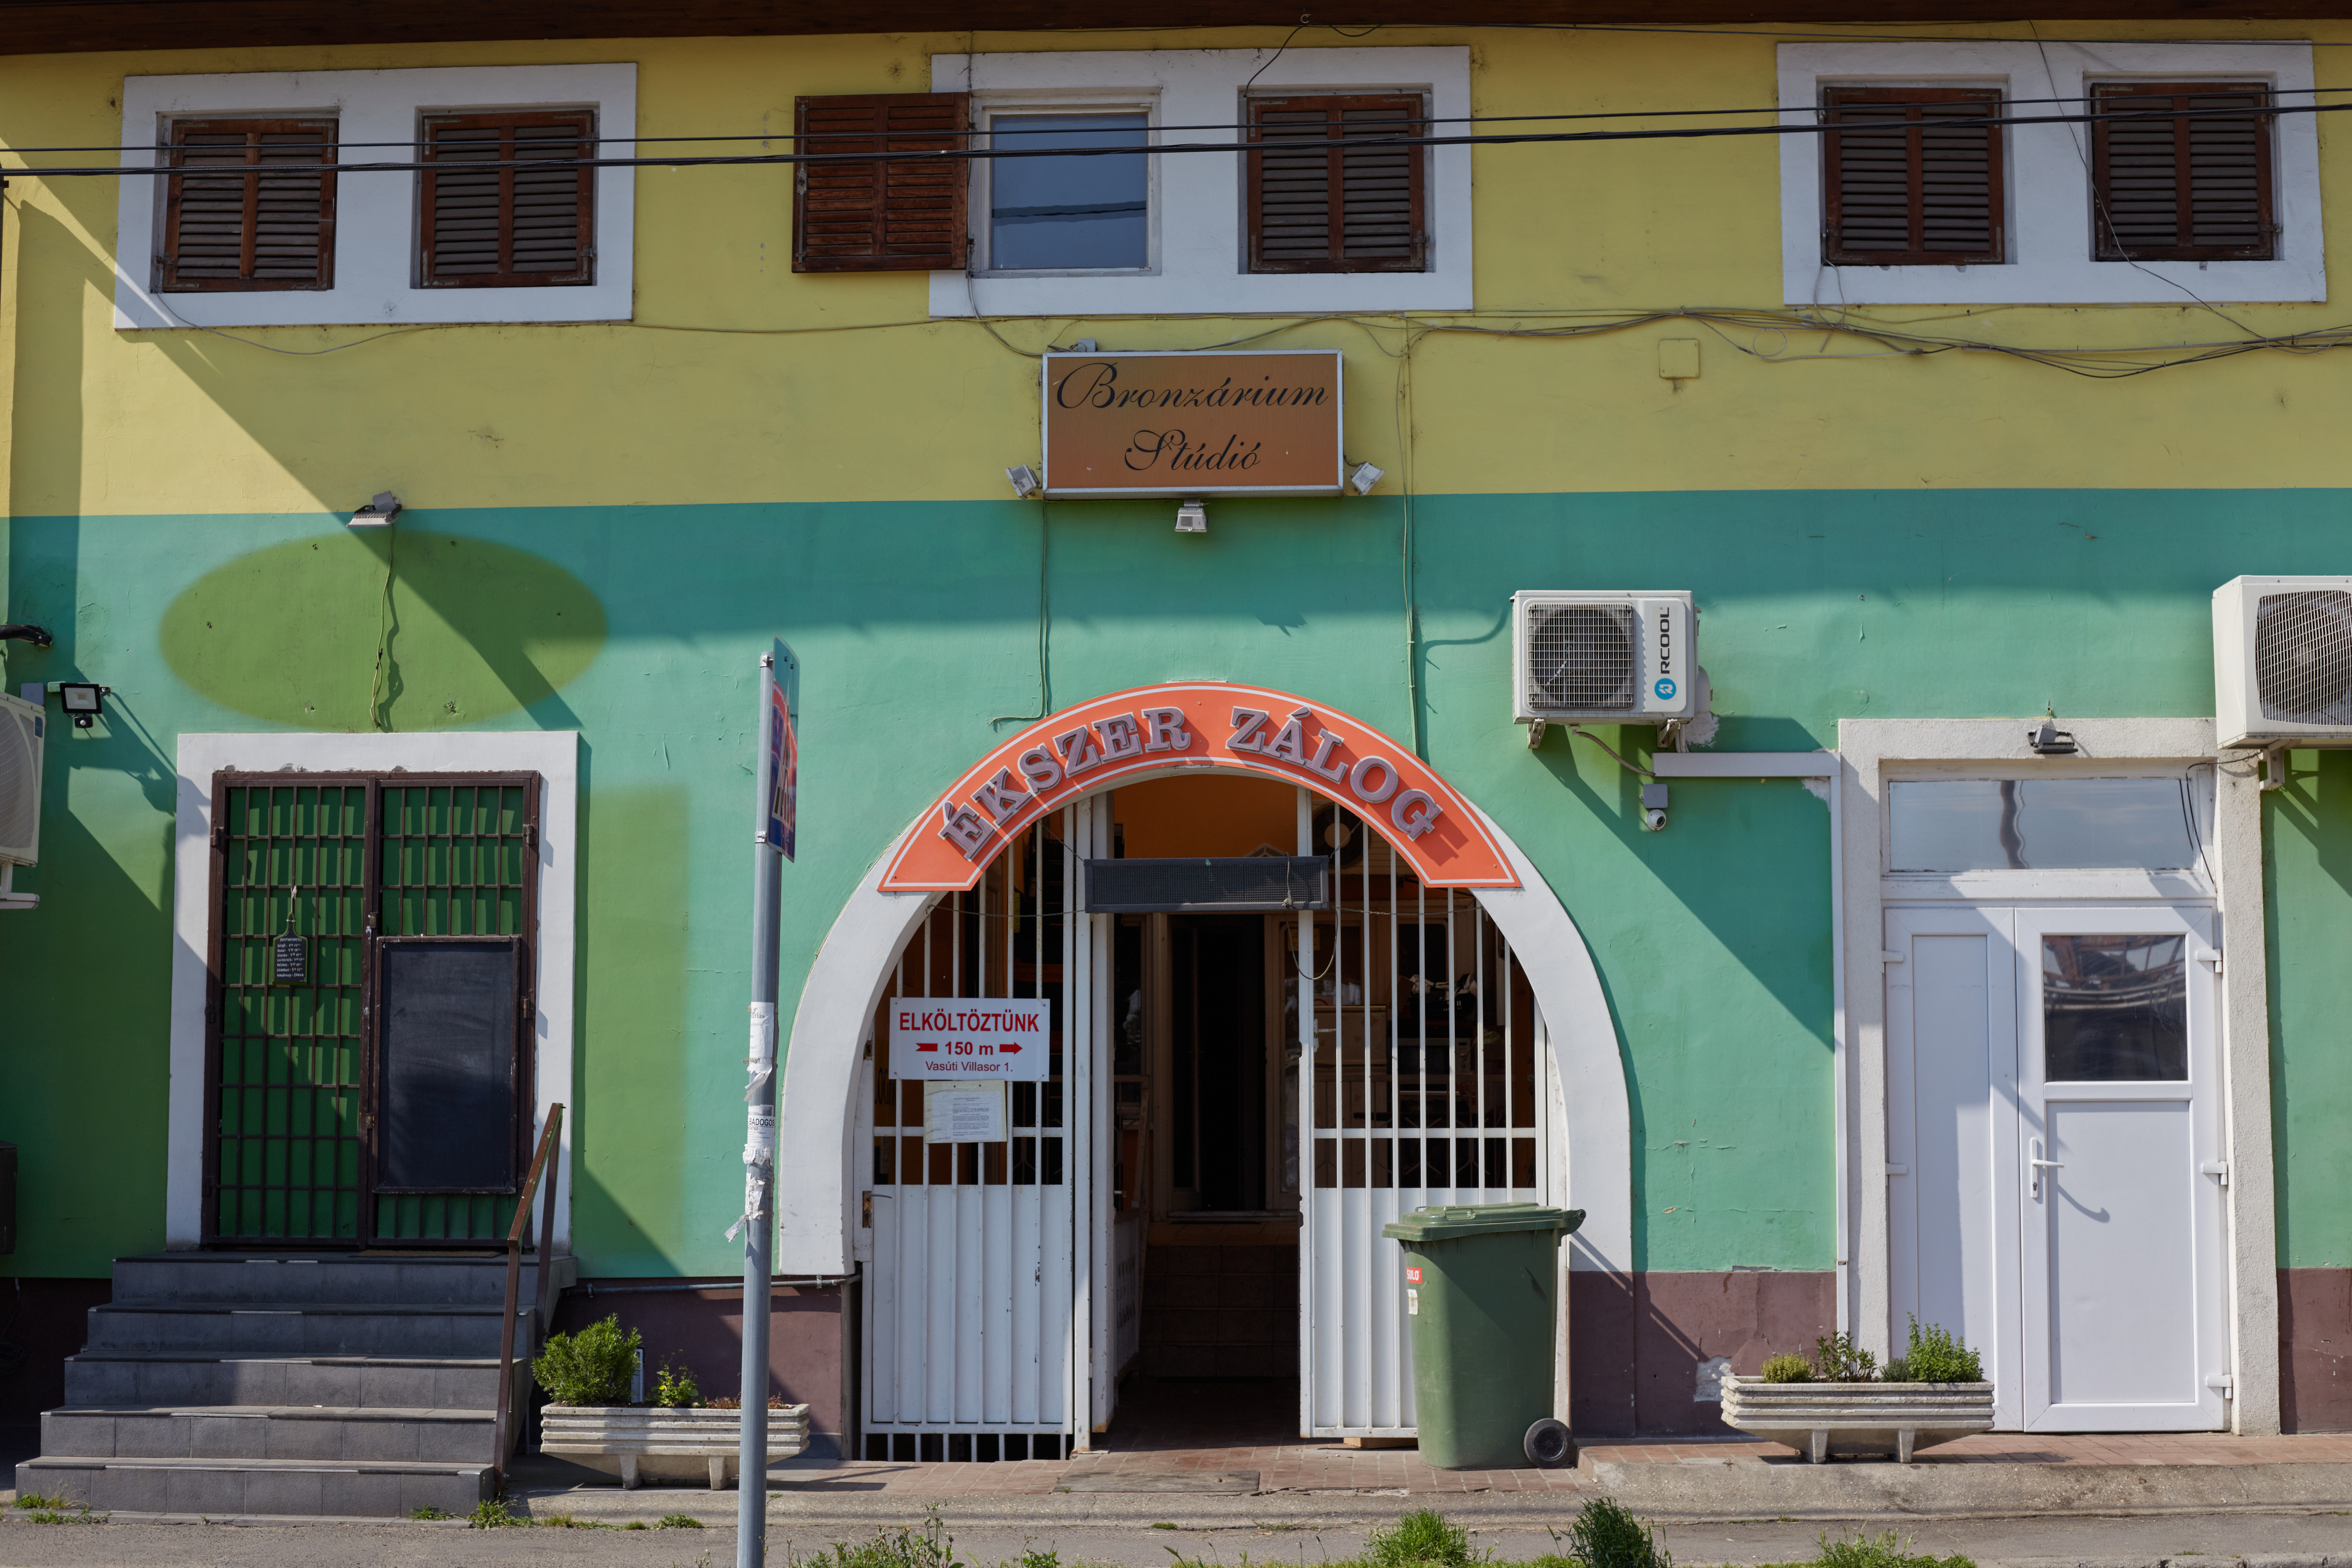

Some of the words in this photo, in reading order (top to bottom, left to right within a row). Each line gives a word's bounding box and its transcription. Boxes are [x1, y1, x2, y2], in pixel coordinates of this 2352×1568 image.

[1056, 362, 1328, 409] Bronzárium
[1124, 429, 1262, 471] Stúdió
[1660, 607, 1670, 674] RCOOL
[938, 706, 1191, 862] ÉKSZER
[1225, 706, 1442, 842] ZÁLOG
[900, 1009, 1039, 1032] ELKÖLTÖZTÜNK
[925, 1061, 958, 1071] Vasúti
[961, 1061, 1000, 1071] Villasor
[1004, 1062, 1013, 1072] 1.
[945, 1041, 973, 1055] 150
[979, 1044, 993, 1055] m
